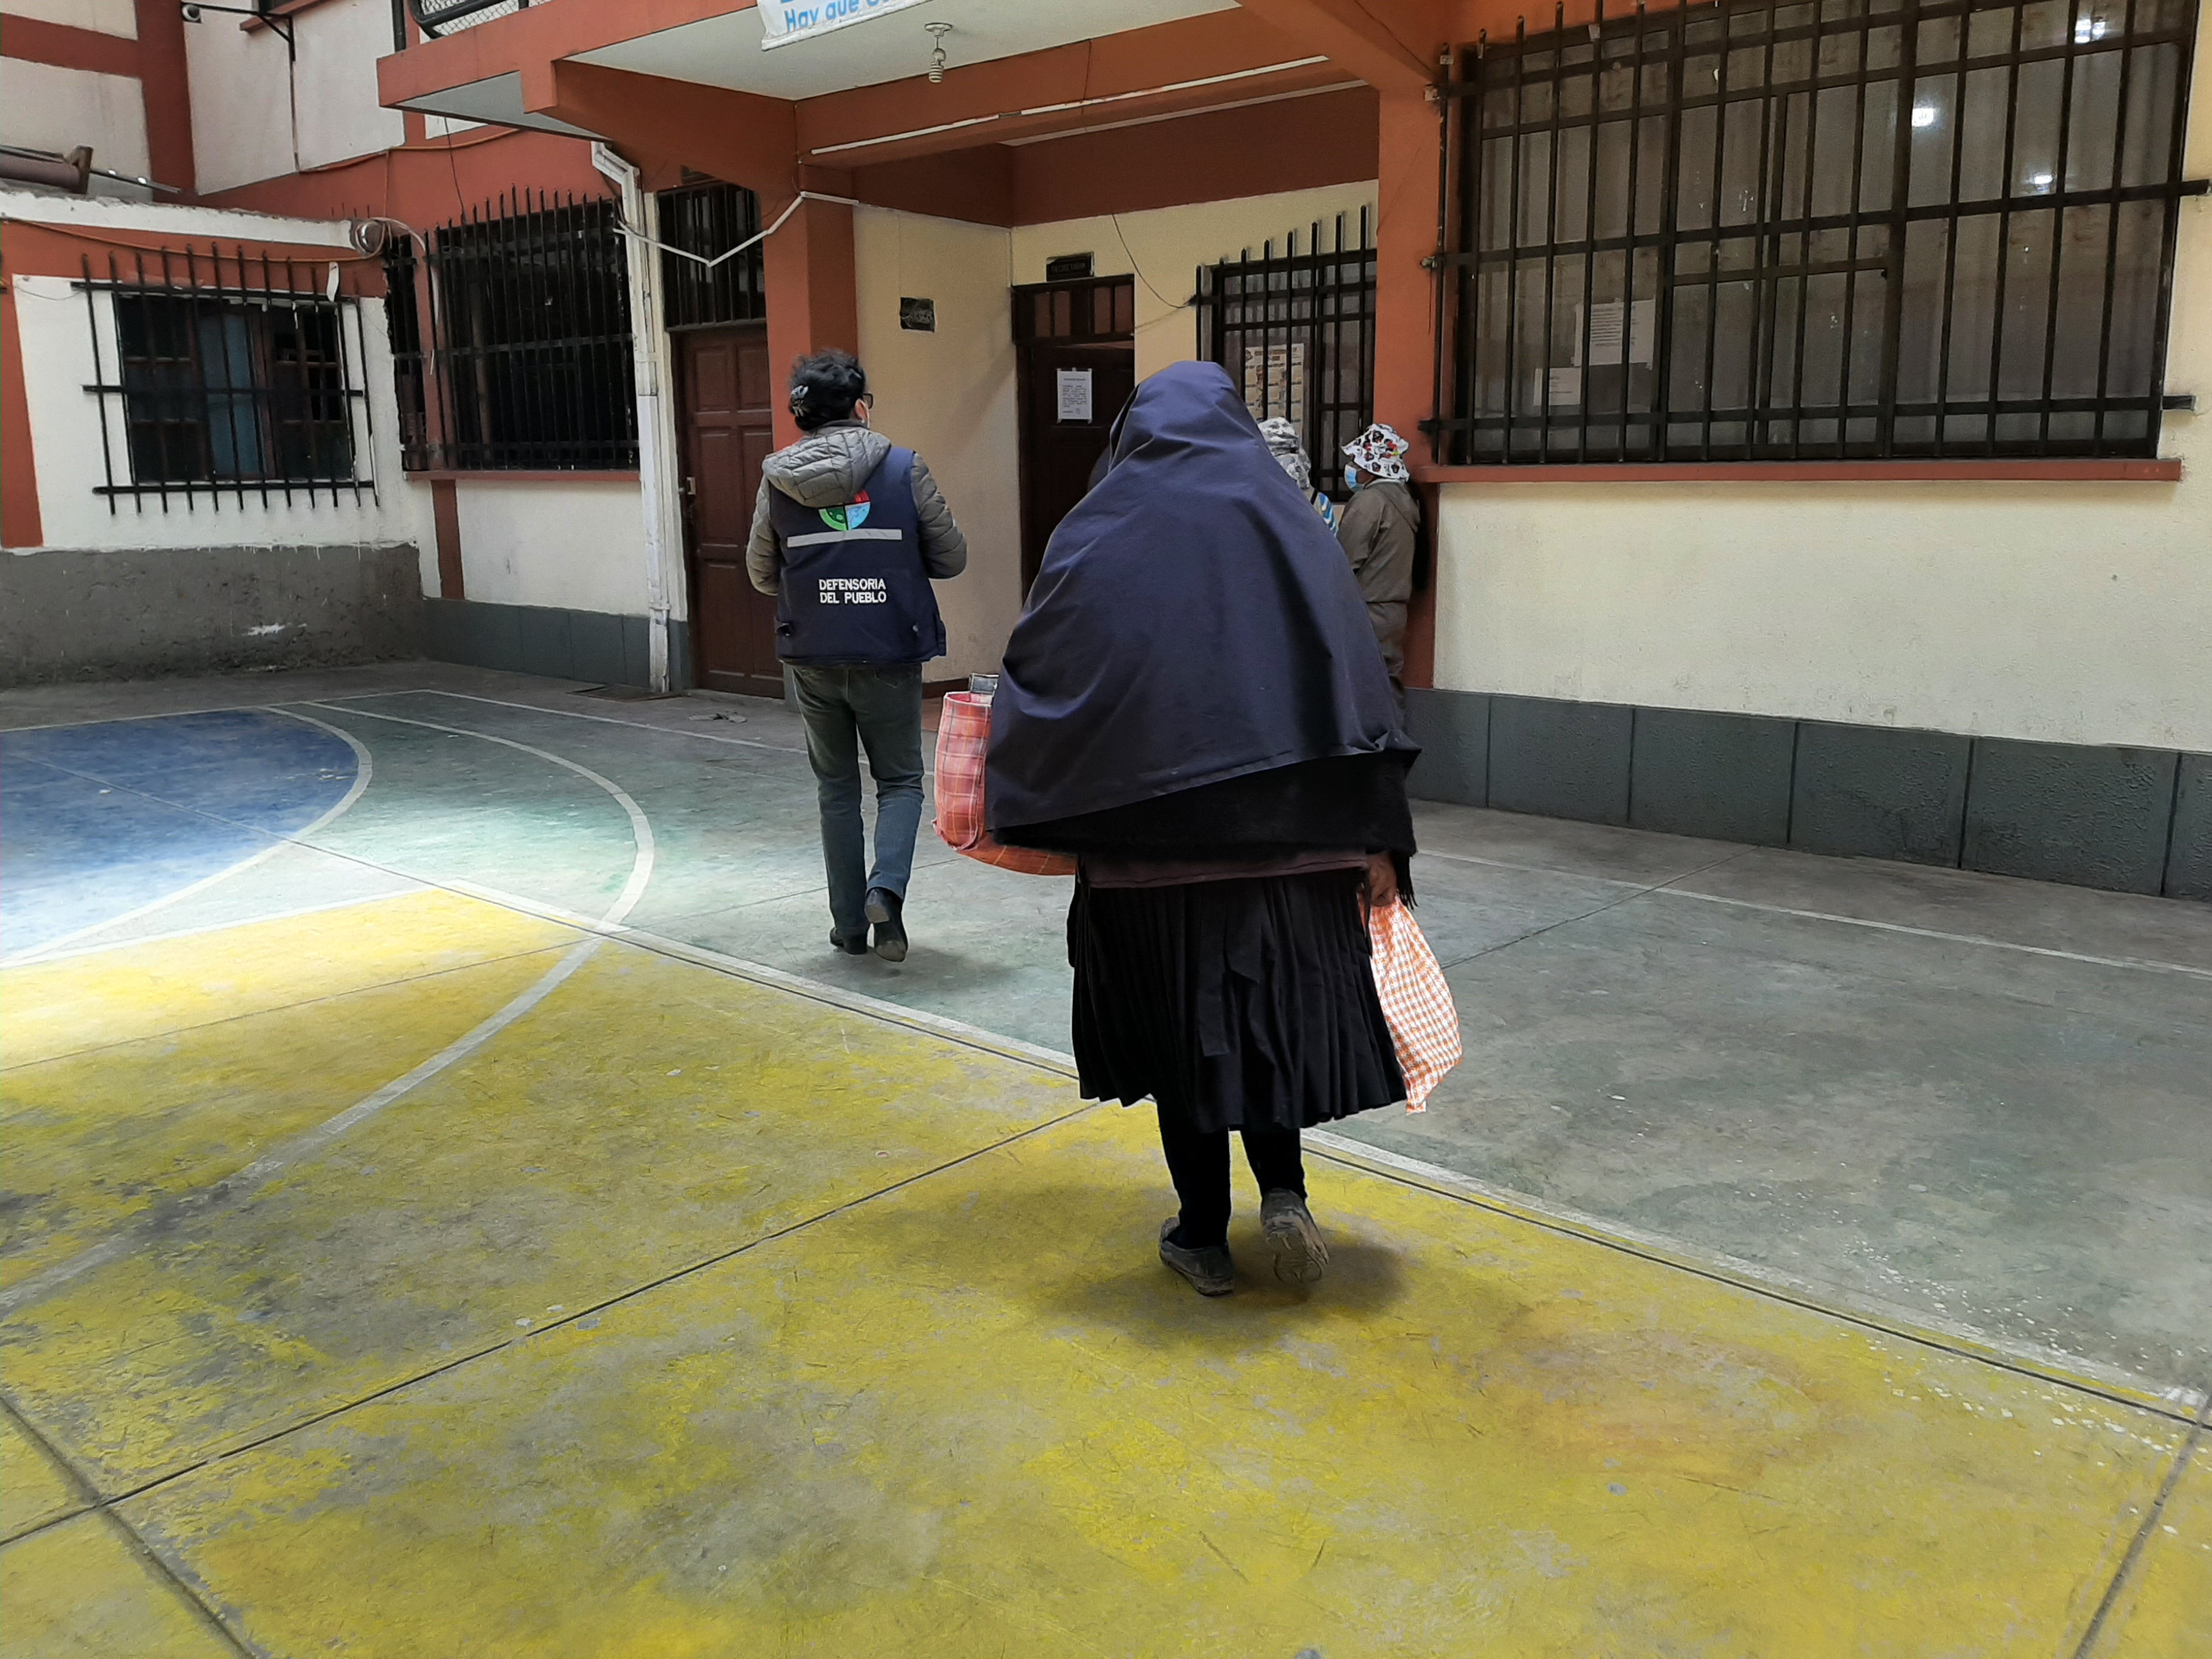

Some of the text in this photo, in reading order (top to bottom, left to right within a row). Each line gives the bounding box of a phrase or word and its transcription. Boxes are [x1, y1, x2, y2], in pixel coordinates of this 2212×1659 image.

[785, 7, 819, 32] Hay
[819, 578, 886, 590] DEFENSORIA
[820, 591, 887, 603] DEL PUEBLO
